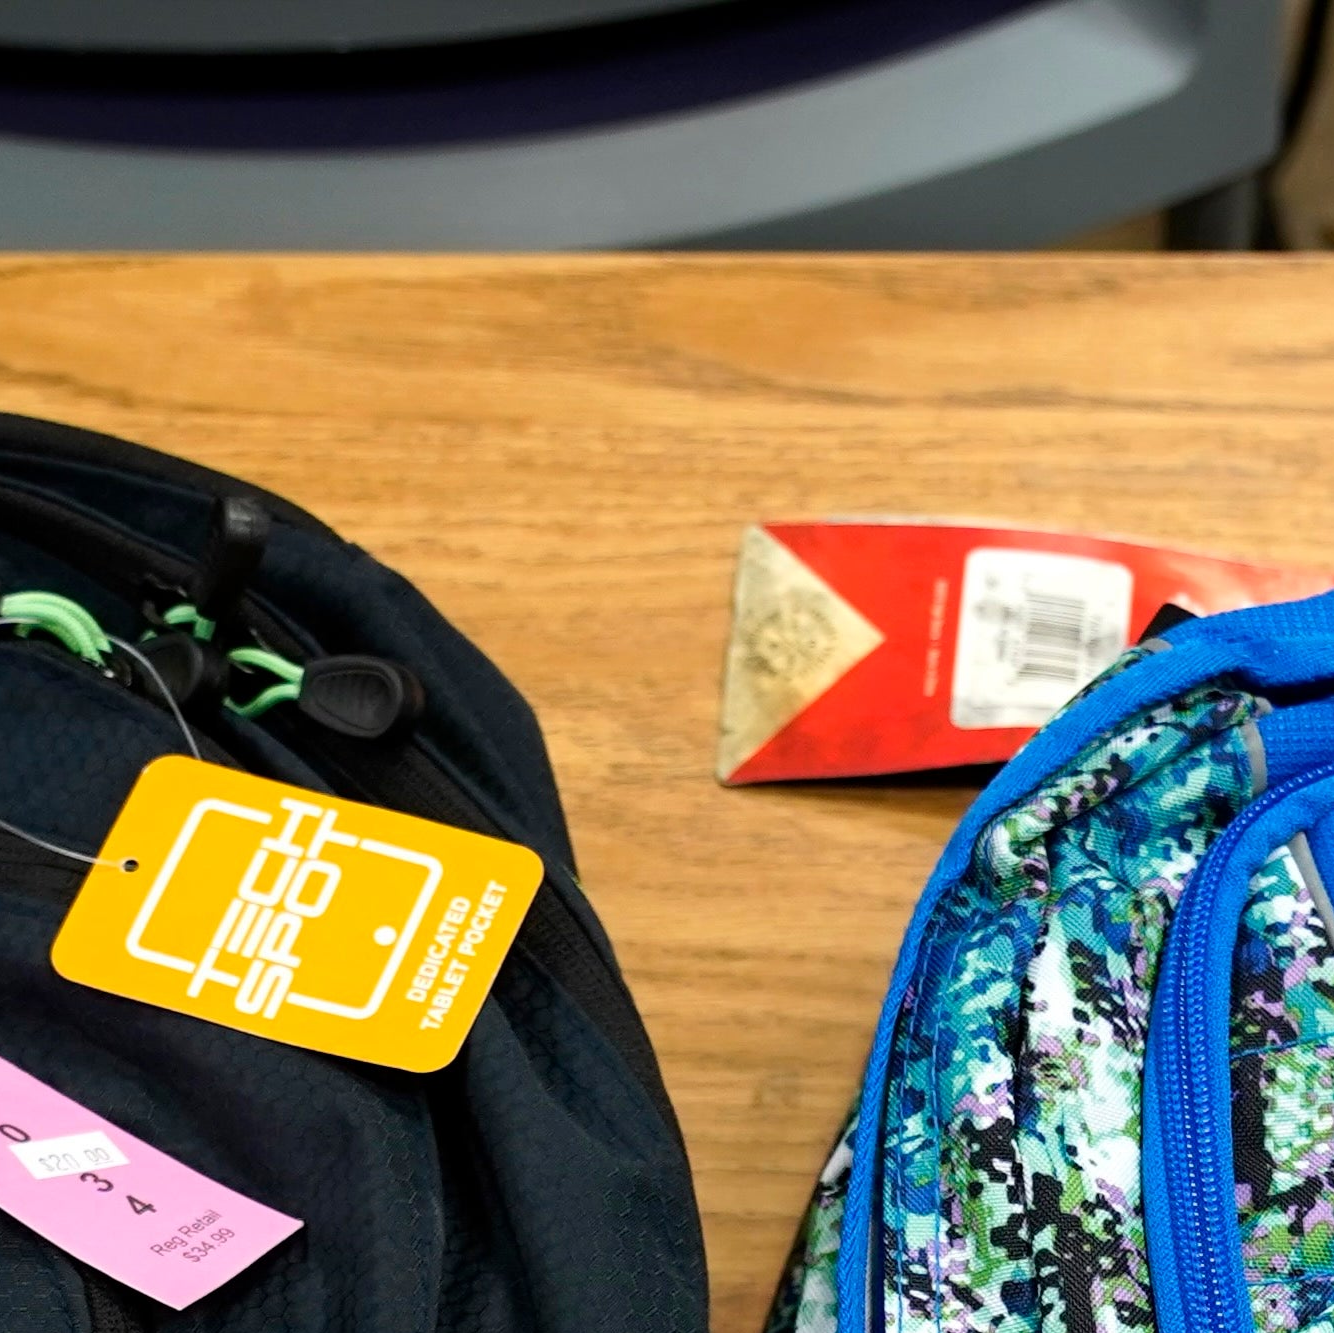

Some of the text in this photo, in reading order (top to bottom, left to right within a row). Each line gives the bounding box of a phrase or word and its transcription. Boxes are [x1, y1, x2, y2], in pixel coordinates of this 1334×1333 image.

[186, 797, 323, 998] TECH
[234, 808, 360, 1020] SPOT
[406, 896, 471, 1002] DEDICATED
[419, 880, 507, 1031] TABLET POCKET
[149, 1209, 222, 1257] Reg Retail
[182, 1227, 236, 1263] $34.99
